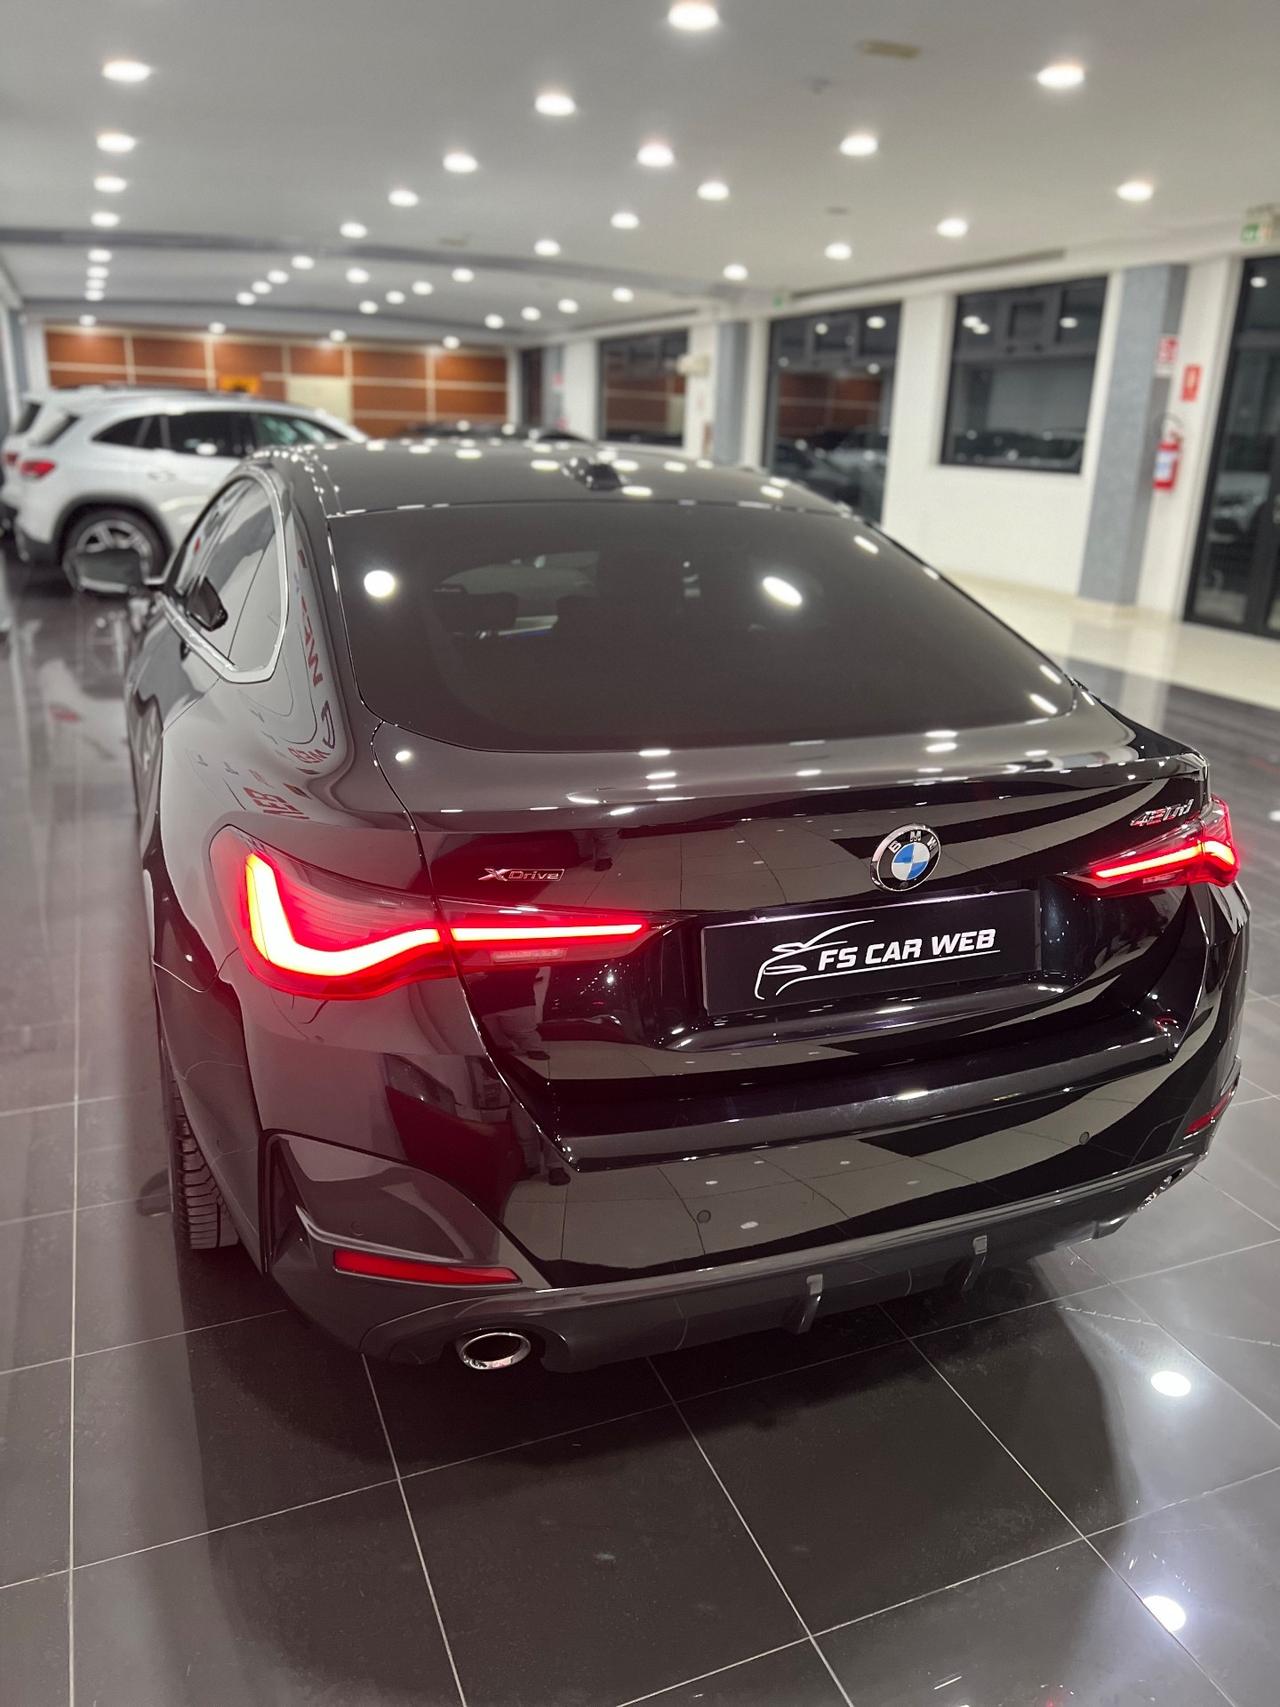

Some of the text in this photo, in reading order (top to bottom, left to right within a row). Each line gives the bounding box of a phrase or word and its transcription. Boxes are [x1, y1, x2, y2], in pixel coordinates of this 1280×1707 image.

[888, 830, 938, 853] BMW
[818, 928, 996, 971] FS CAR WEB
